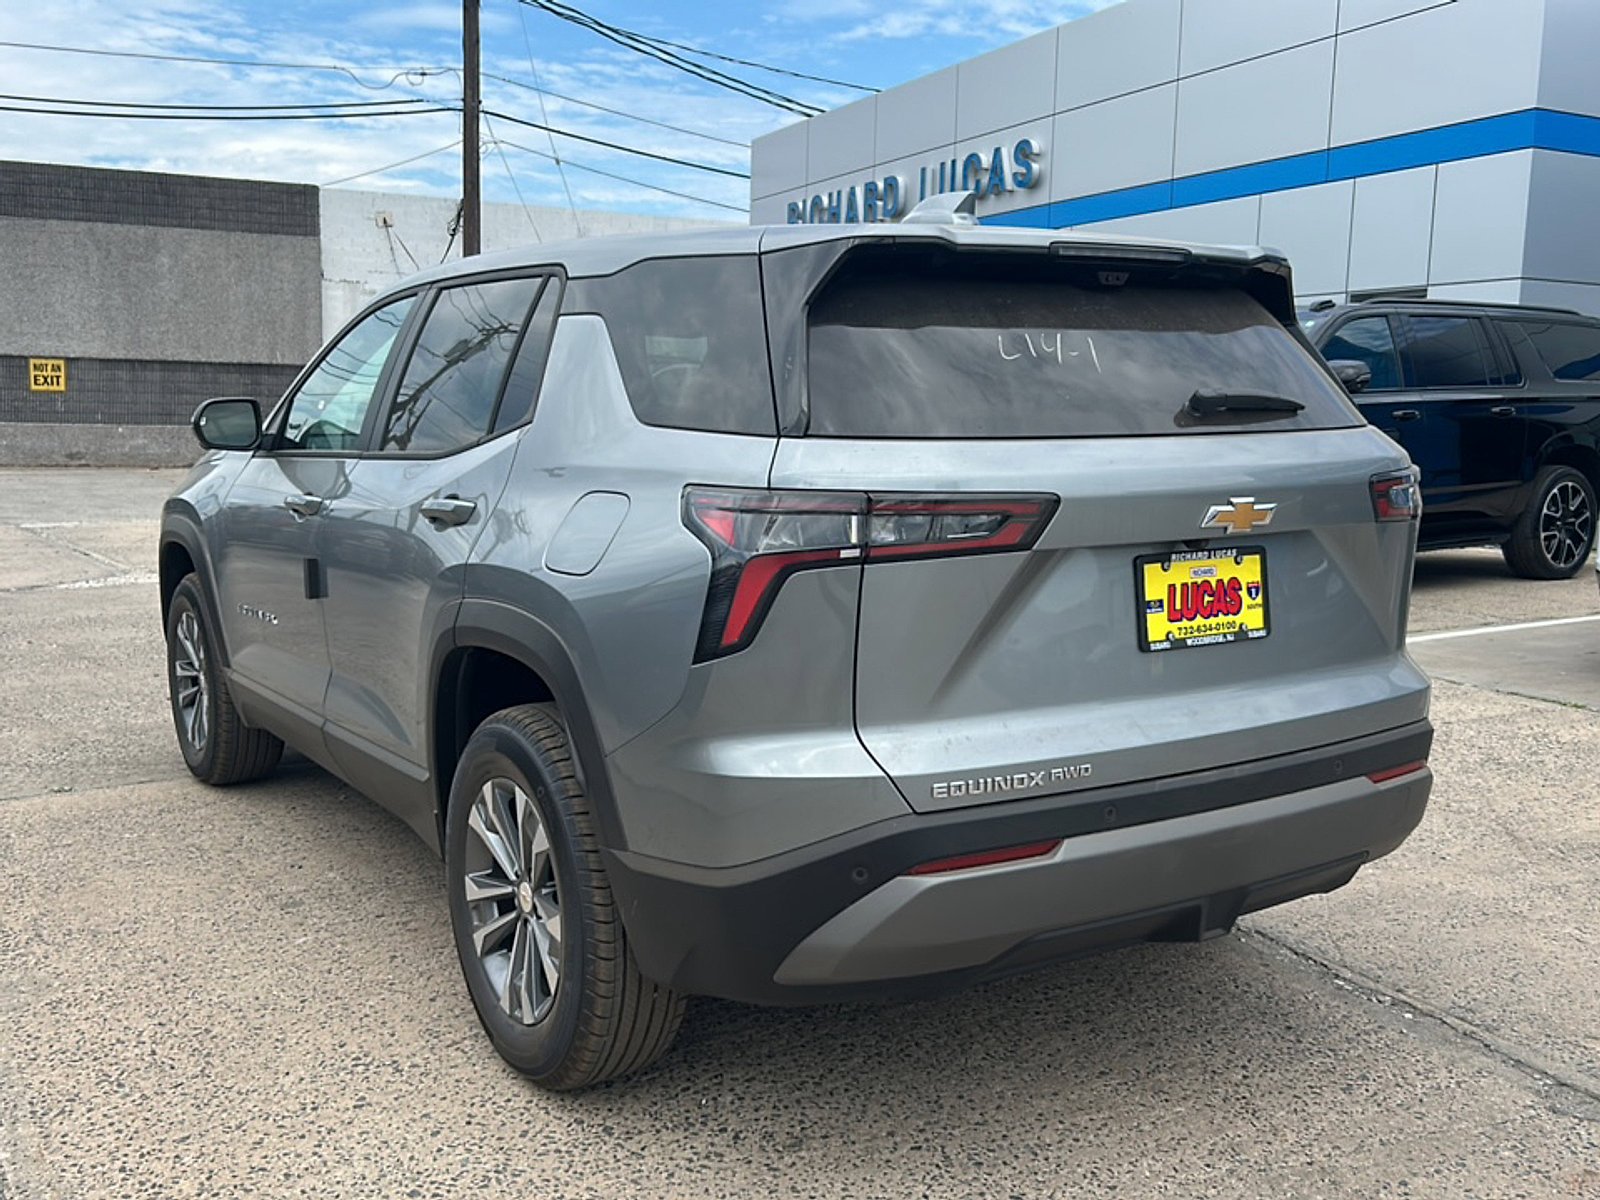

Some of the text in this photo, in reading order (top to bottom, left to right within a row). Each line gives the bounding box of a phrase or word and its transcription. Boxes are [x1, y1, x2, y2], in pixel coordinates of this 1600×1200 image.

[787, 175, 902, 224] RICHARD
[33, 363, 62, 373] NOT AN
[33, 375, 62, 387] EXIT
[1171, 549, 1237, 562] RICHARD LUCAS
[1168, 577, 1242, 622] LUCAS
[1177, 621, 1236, 635] 732-634-0100
[932, 763, 1092, 799] EQUINOX AWD
